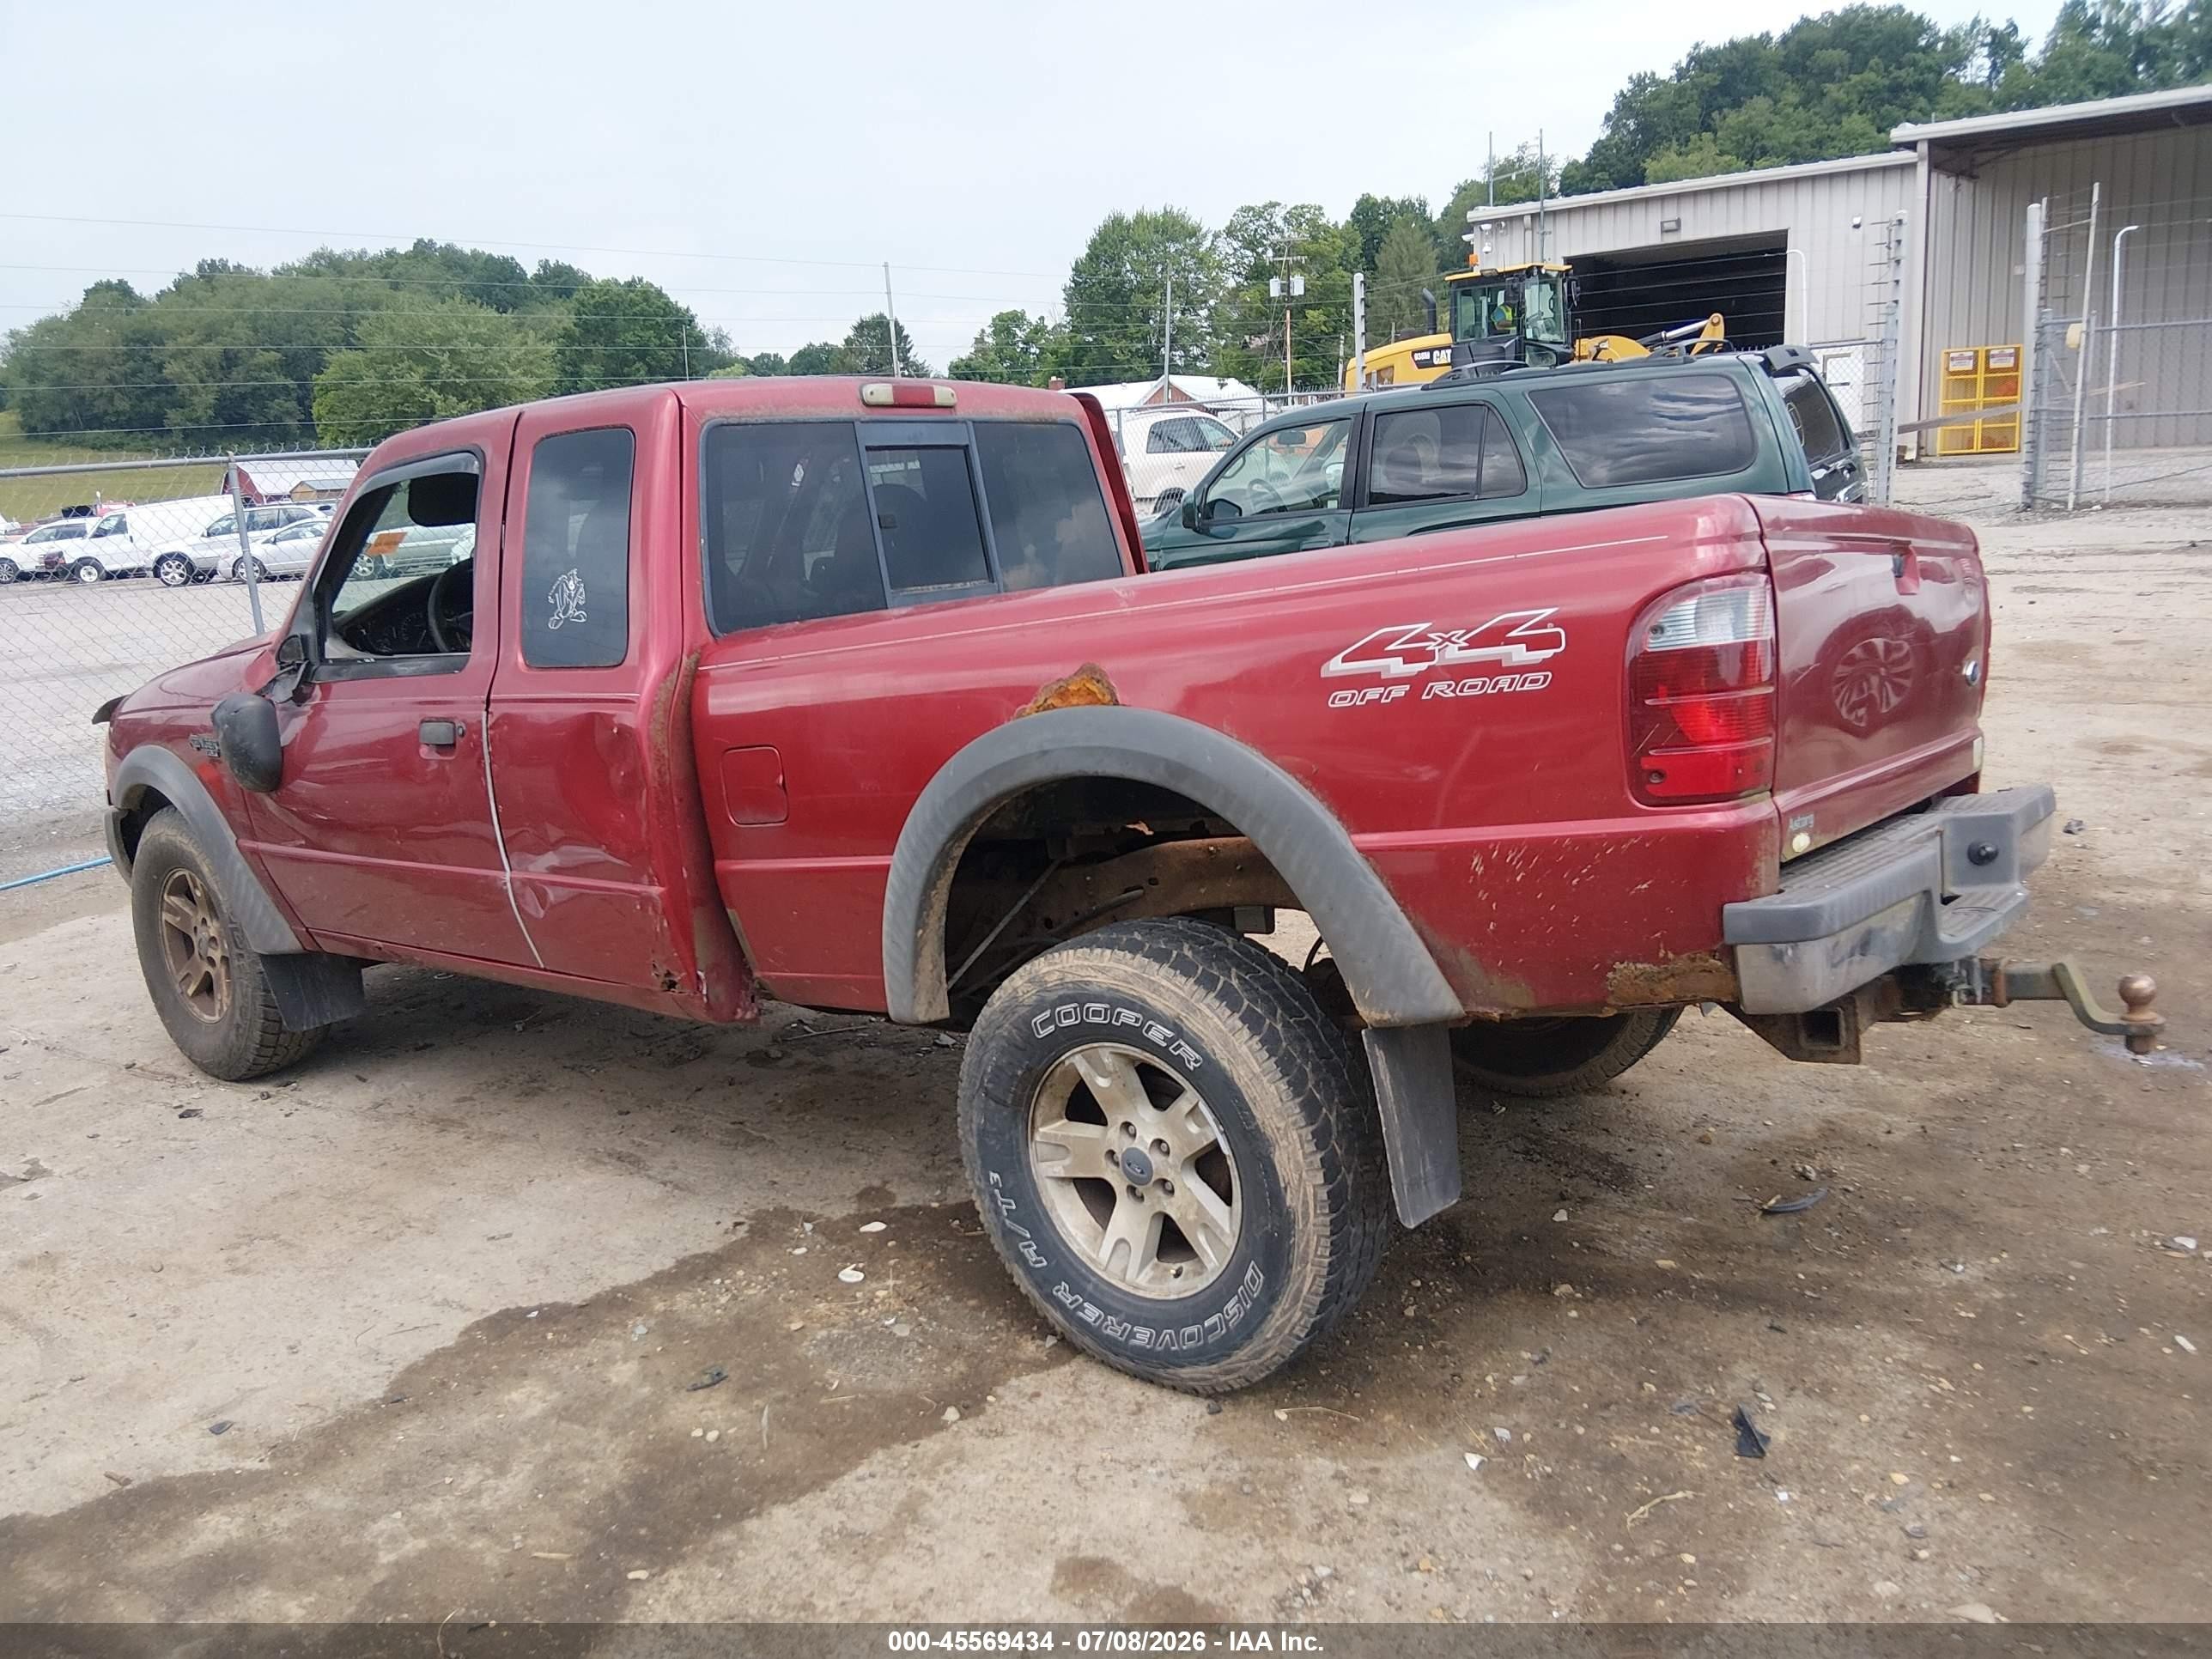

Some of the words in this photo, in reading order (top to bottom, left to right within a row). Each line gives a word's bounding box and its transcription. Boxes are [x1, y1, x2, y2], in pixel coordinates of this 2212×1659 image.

[1432, 349, 1452, 365] CAT
[1328, 684, 1410, 708] OFF
[1421, 671, 1553, 700] ROAD
[1030, 1002, 1202, 1073] COOPER
[1052, 1260, 1265, 1351] DISCOVERER
